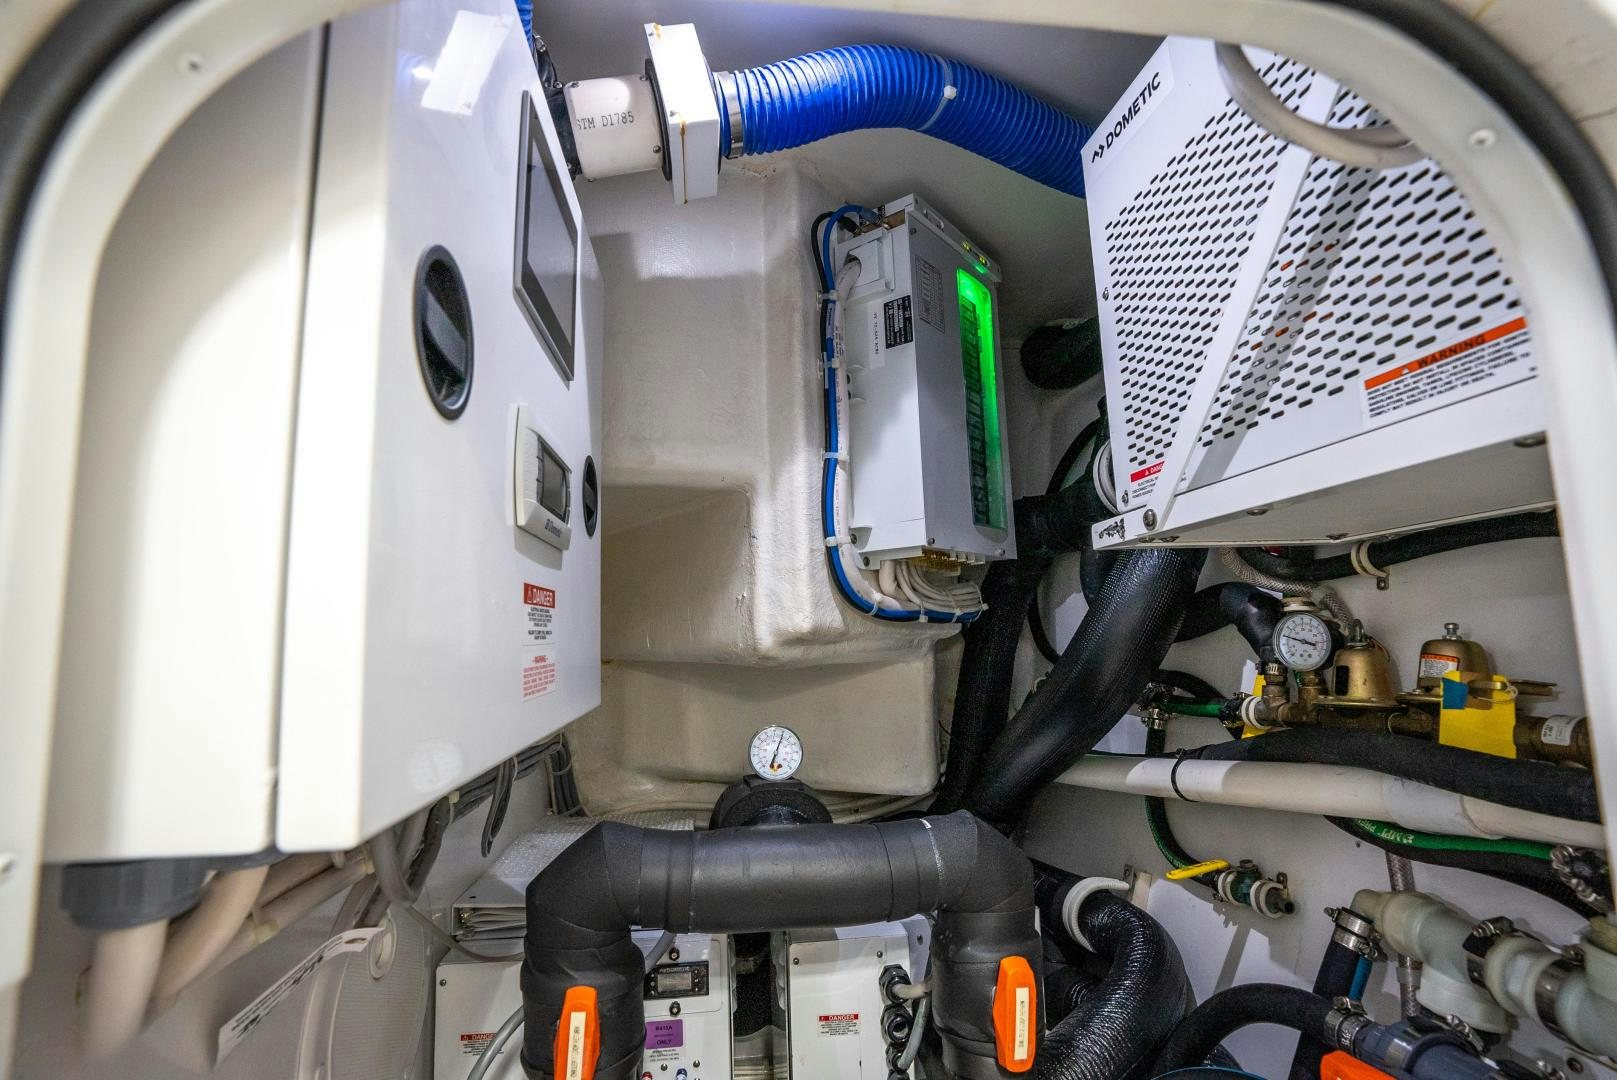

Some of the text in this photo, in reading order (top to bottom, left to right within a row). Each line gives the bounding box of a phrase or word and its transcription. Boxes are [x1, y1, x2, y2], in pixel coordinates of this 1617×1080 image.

[601, 111, 635, 127] D1785
[1105, 72, 1161, 150] DOMETIC
[1418, 336, 1486, 370] WARNING
[532, 587, 554, 606] DANGER
[656, 1039, 672, 1047] ONLY
